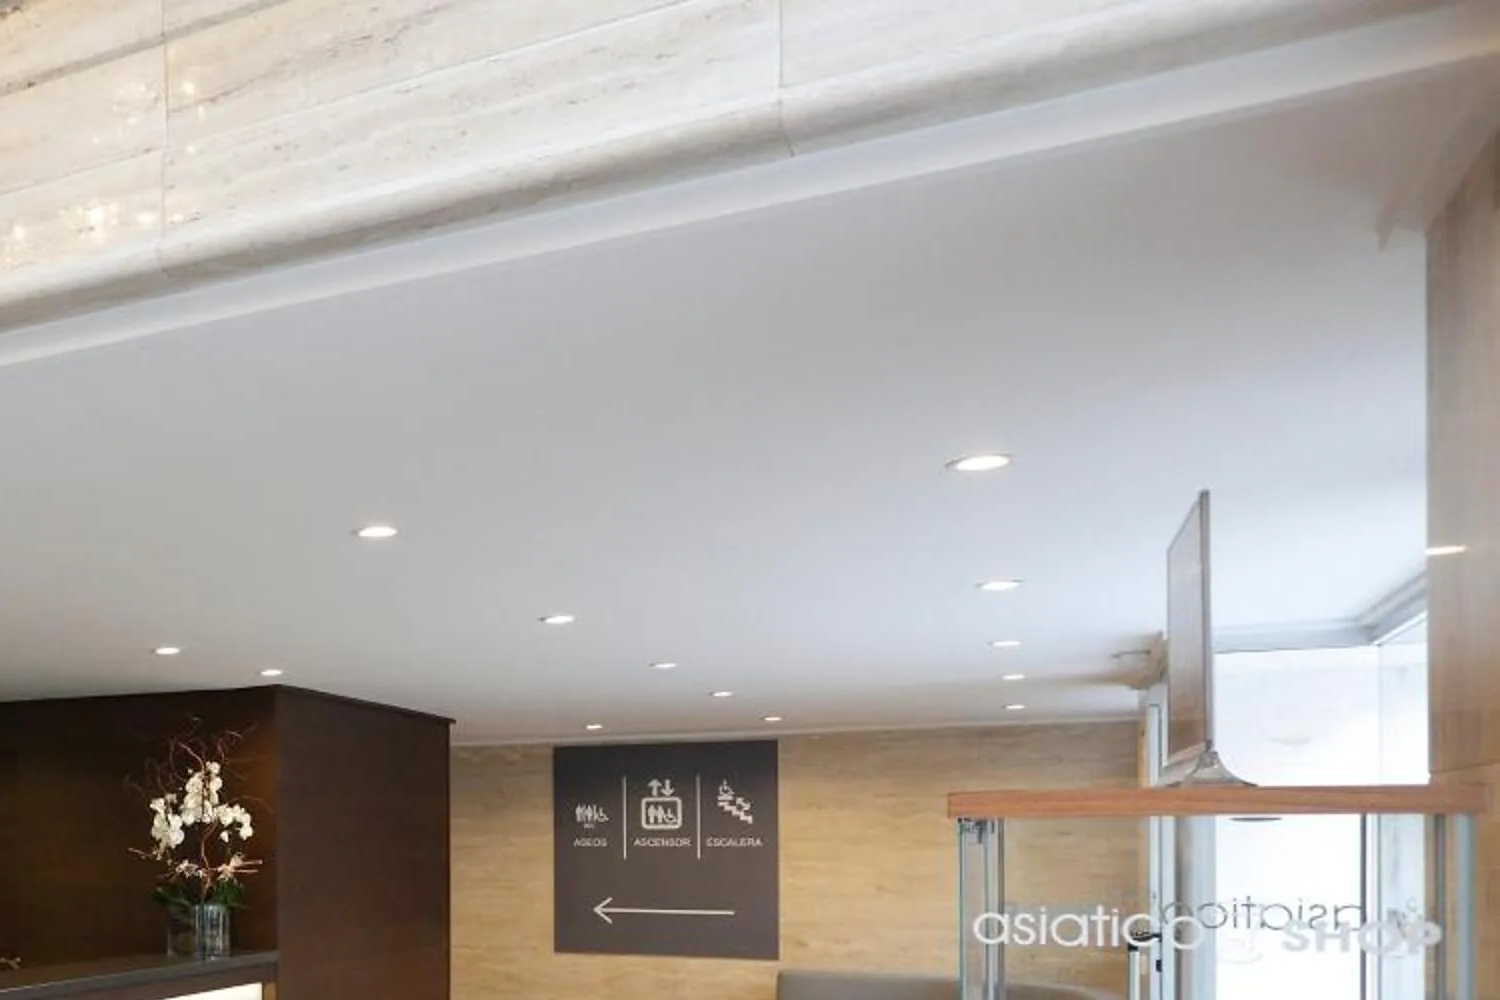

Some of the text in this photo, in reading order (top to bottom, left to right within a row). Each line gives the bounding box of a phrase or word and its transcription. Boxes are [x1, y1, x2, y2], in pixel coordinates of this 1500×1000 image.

[573, 836, 608, 848] ASEOS
[633, 836, 692, 848] ASCENSOR
[706, 836, 764, 848] ESCALERA
[973, 904, 1443, 954] asiatico SHOP
